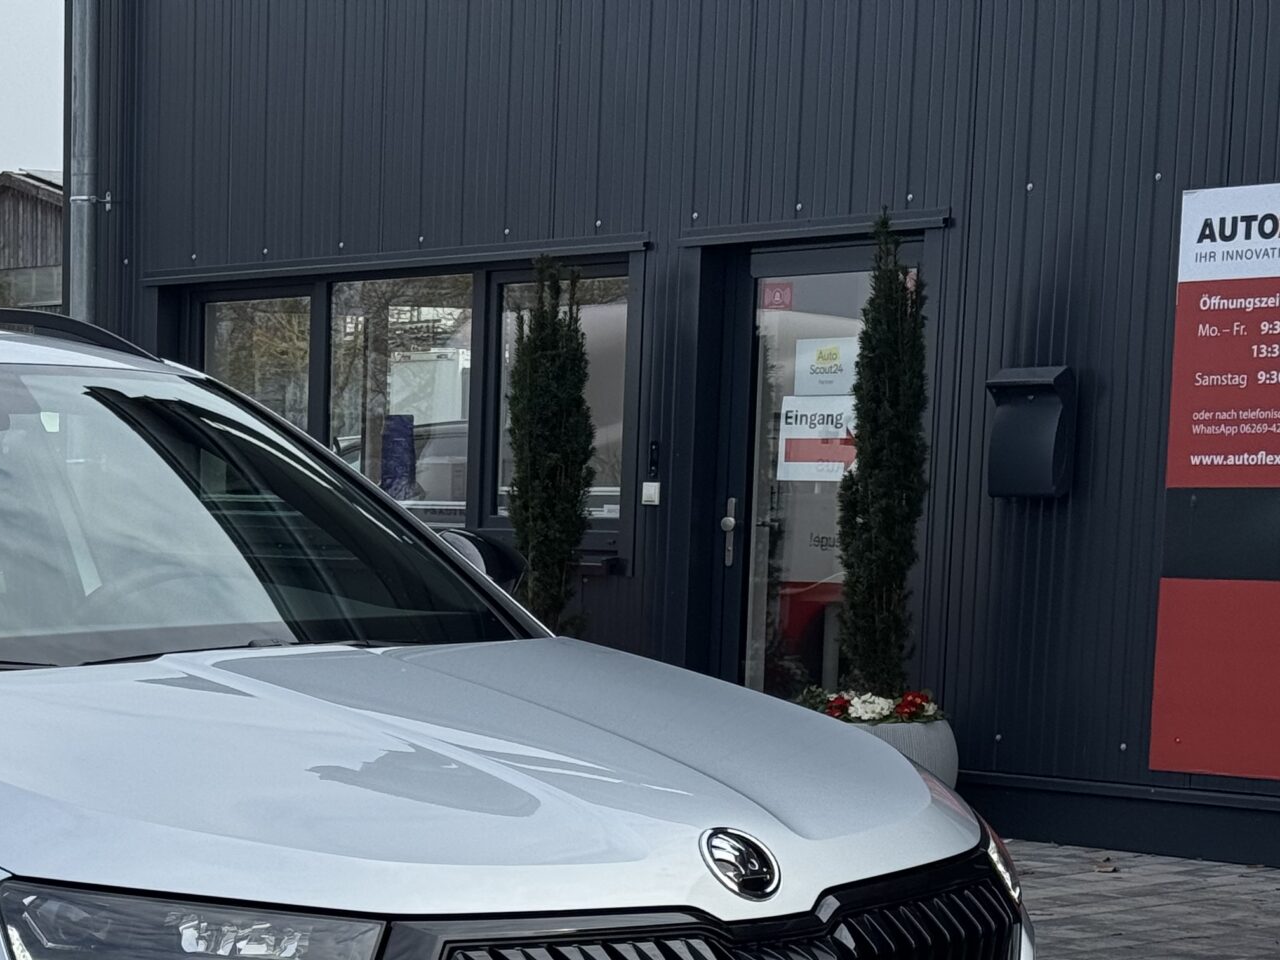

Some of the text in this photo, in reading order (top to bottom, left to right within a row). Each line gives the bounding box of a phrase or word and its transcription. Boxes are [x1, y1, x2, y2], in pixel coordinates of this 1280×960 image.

[1196, 213, 1280, 243] AUTO
[1195, 251, 1216, 262] IHR
[817, 350, 838, 361] Auto
[809, 363, 843, 375] Scout24
[1194, 372, 1248, 388] Samstag
[784, 410, 844, 429] Eingang
[1192, 409, 1214, 420] oder
[1215, 409, 1237, 419] nach
[1192, 424, 1238, 436] WhatsApp
